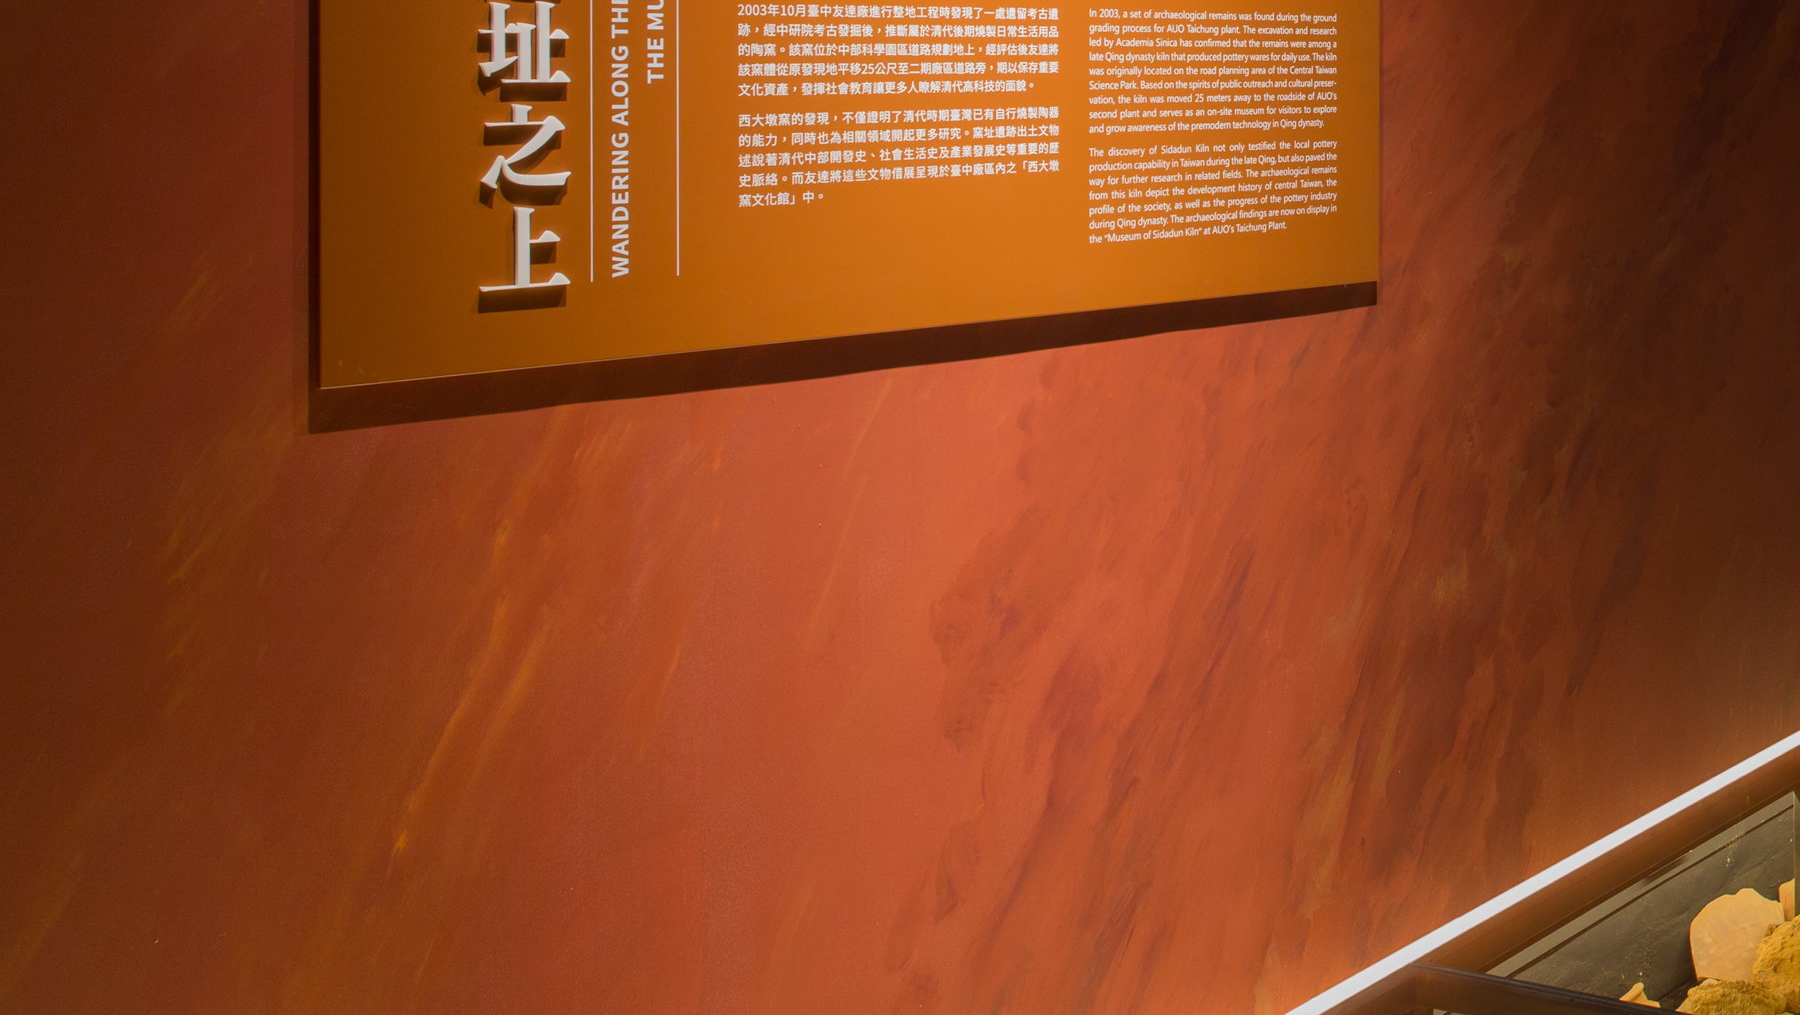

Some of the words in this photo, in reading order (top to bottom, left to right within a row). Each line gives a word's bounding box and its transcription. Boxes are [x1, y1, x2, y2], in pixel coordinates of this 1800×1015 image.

[1088, 8, 1097, 17] In
[1099, 8, 1120, 19] 2003,
[1122, 10, 1128, 18] a
[1129, 10, 1142, 18] set
[1143, 9, 1152, 18] of
[1153, 9, 1207, 22] archaeological
[1208, 11, 1237, 20] remains
[1253, 11, 1274, 21] found
[1276, 12, 1298, 23] during
[1300, 12, 1311, 21] the
[1312, 13, 1337, 24] ground
[1088, 22, 1120, 35] grading
[1121, 25, 1152, 34] process
[1153, 23, 1165, 33] for
[1166, 23, 1184, 33] AUO
[1186, 23, 1219, 36] Taichung
[1220, 24, 1240, 35] plant.
[1242, 24, 1256, 34] The
[1257, 25, 1293, 34] excavation
[1294, 25, 1308, 35] and
[1309, 26, 1337, 35] research
[1088, 37, 1102, 47] led
[1103, 37, 1114, 49] by
[1115, 37, 1154, 47] Academia
[1155, 37, 1177, 47] Sinica
[1179, 37, 1192, 47] has
[1193, 37, 1231, 47] confirmed
[1232, 38, 1247, 47] that
[1248, 38, 1260, 48] the
[1261, 39, 1289, 48] remains
[1290, 40, 1306, 48] were
[1307, 41, 1331, 50] among
[647, 37, 665, 84] THE
[1106, 65, 1142, 78] originally
[1143, 65, 1172, 75] located
[1173, 67, 1184, 75] on
[1185, 65, 1198, 75] the
[1199, 65, 1216, 75] road
[1218, 65, 1249, 77] planning
[1267, 65, 1275, 74] of
[1276, 65, 1288, 74] the
[1289, 65, 1313, 74] Central
[1314, 65, 1337, 74] Taiwan
[611, 45, 630, 126] ALONG
[1088, 94, 1115, 105] vation,
[1117, 94, 1131, 104] the
[1133, 94, 1147, 103] kiln
[1166, 93, 1192, 103] moved
[1194, 93, 1204, 102] 25
[1206, 93, 1231, 102] meters
[1233, 94, 1251, 104] away
[1253, 93, 1261, 101] to
[1263, 92, 1275, 101] the
[1276, 91, 1306, 101] roadside
[1307, 91, 1315, 100] of
[1088, 109, 1117, 119] second
[1119, 108, 1140, 120] plant
[1142, 107, 1157, 118] and
[1159, 109, 1183, 117] serves
[1206, 106, 1232, 116] on-site
[1234, 107, 1264, 115] museum
[1266, 105, 1276, 114] for
[1278, 105, 1302, 114] visitors
[1303, 105, 1311, 113] to
[1313, 104, 1337, 115] explore
[1088, 146, 1104, 157] The
[1107, 145, 1145, 158] discovery
[1148, 144, 1157, 154] of
[1161, 144, 1192, 154] Sidadun
[1195, 143, 1209, 152] Kiln
[1213, 143, 1226, 152] not
[1229, 142, 1245, 153] only
[1247, 140, 1276, 151] testified
[1279, 140, 1291, 149] the
[1293, 139, 1309, 149] local
[1313, 139, 1337, 150] pottery
[1088, 177, 1105, 188] way
[1107, 174, 1119, 185] for
[1121, 173, 1148, 184] further
[1150, 172, 1182, 183] research
[1184, 171, 1192, 181] in
[1194, 170, 1220, 181] related
[1222, 169, 1243, 179] fields.
[1245, 168, 1258, 178] The
[1260, 166, 1309, 179] archaeological
[1311, 165, 1337, 174] remains
[1088, 189, 1108, 200] from
[1110, 189, 1126, 199] this
[1128, 188, 1142, 198] kiln
[1145, 187, 1169, 199] depict
[1171, 185, 1185, 196] the
[1187, 183, 1235, 196] development
[1237, 182, 1262, 194] history
[1264, 180, 1272, 190] of
[1274, 179, 1297, 190] central
[1299, 178, 1323, 188] Taiwan,
[1325, 177, 1337, 186] the
[611, 132, 630, 278] WANDERING
[1088, 203, 1115, 217] profile
[1117, 202, 1125, 213] of
[1128, 202, 1141, 212] the
[1143, 201, 1172, 214] society,
[1173, 201, 1183, 210] as
[1184, 198, 1200, 209] well
[1202, 200, 1211, 208] as
[1212, 197, 1225, 207] the
[1227, 197, 1258, 208] progress
[1260, 194, 1268, 204] of
[1269, 193, 1281, 203] the
[1283, 193, 1308, 204] pottery
[1310, 190, 1337, 202] industry
[1088, 233, 1103, 244] the
[1142, 229, 1151, 240] of
[1152, 227, 1183, 239] Sidadun
[1203, 226, 1211, 235] at
[1235, 221, 1266, 234] Taichung
[1268, 220, 1287, 230] Plant.
